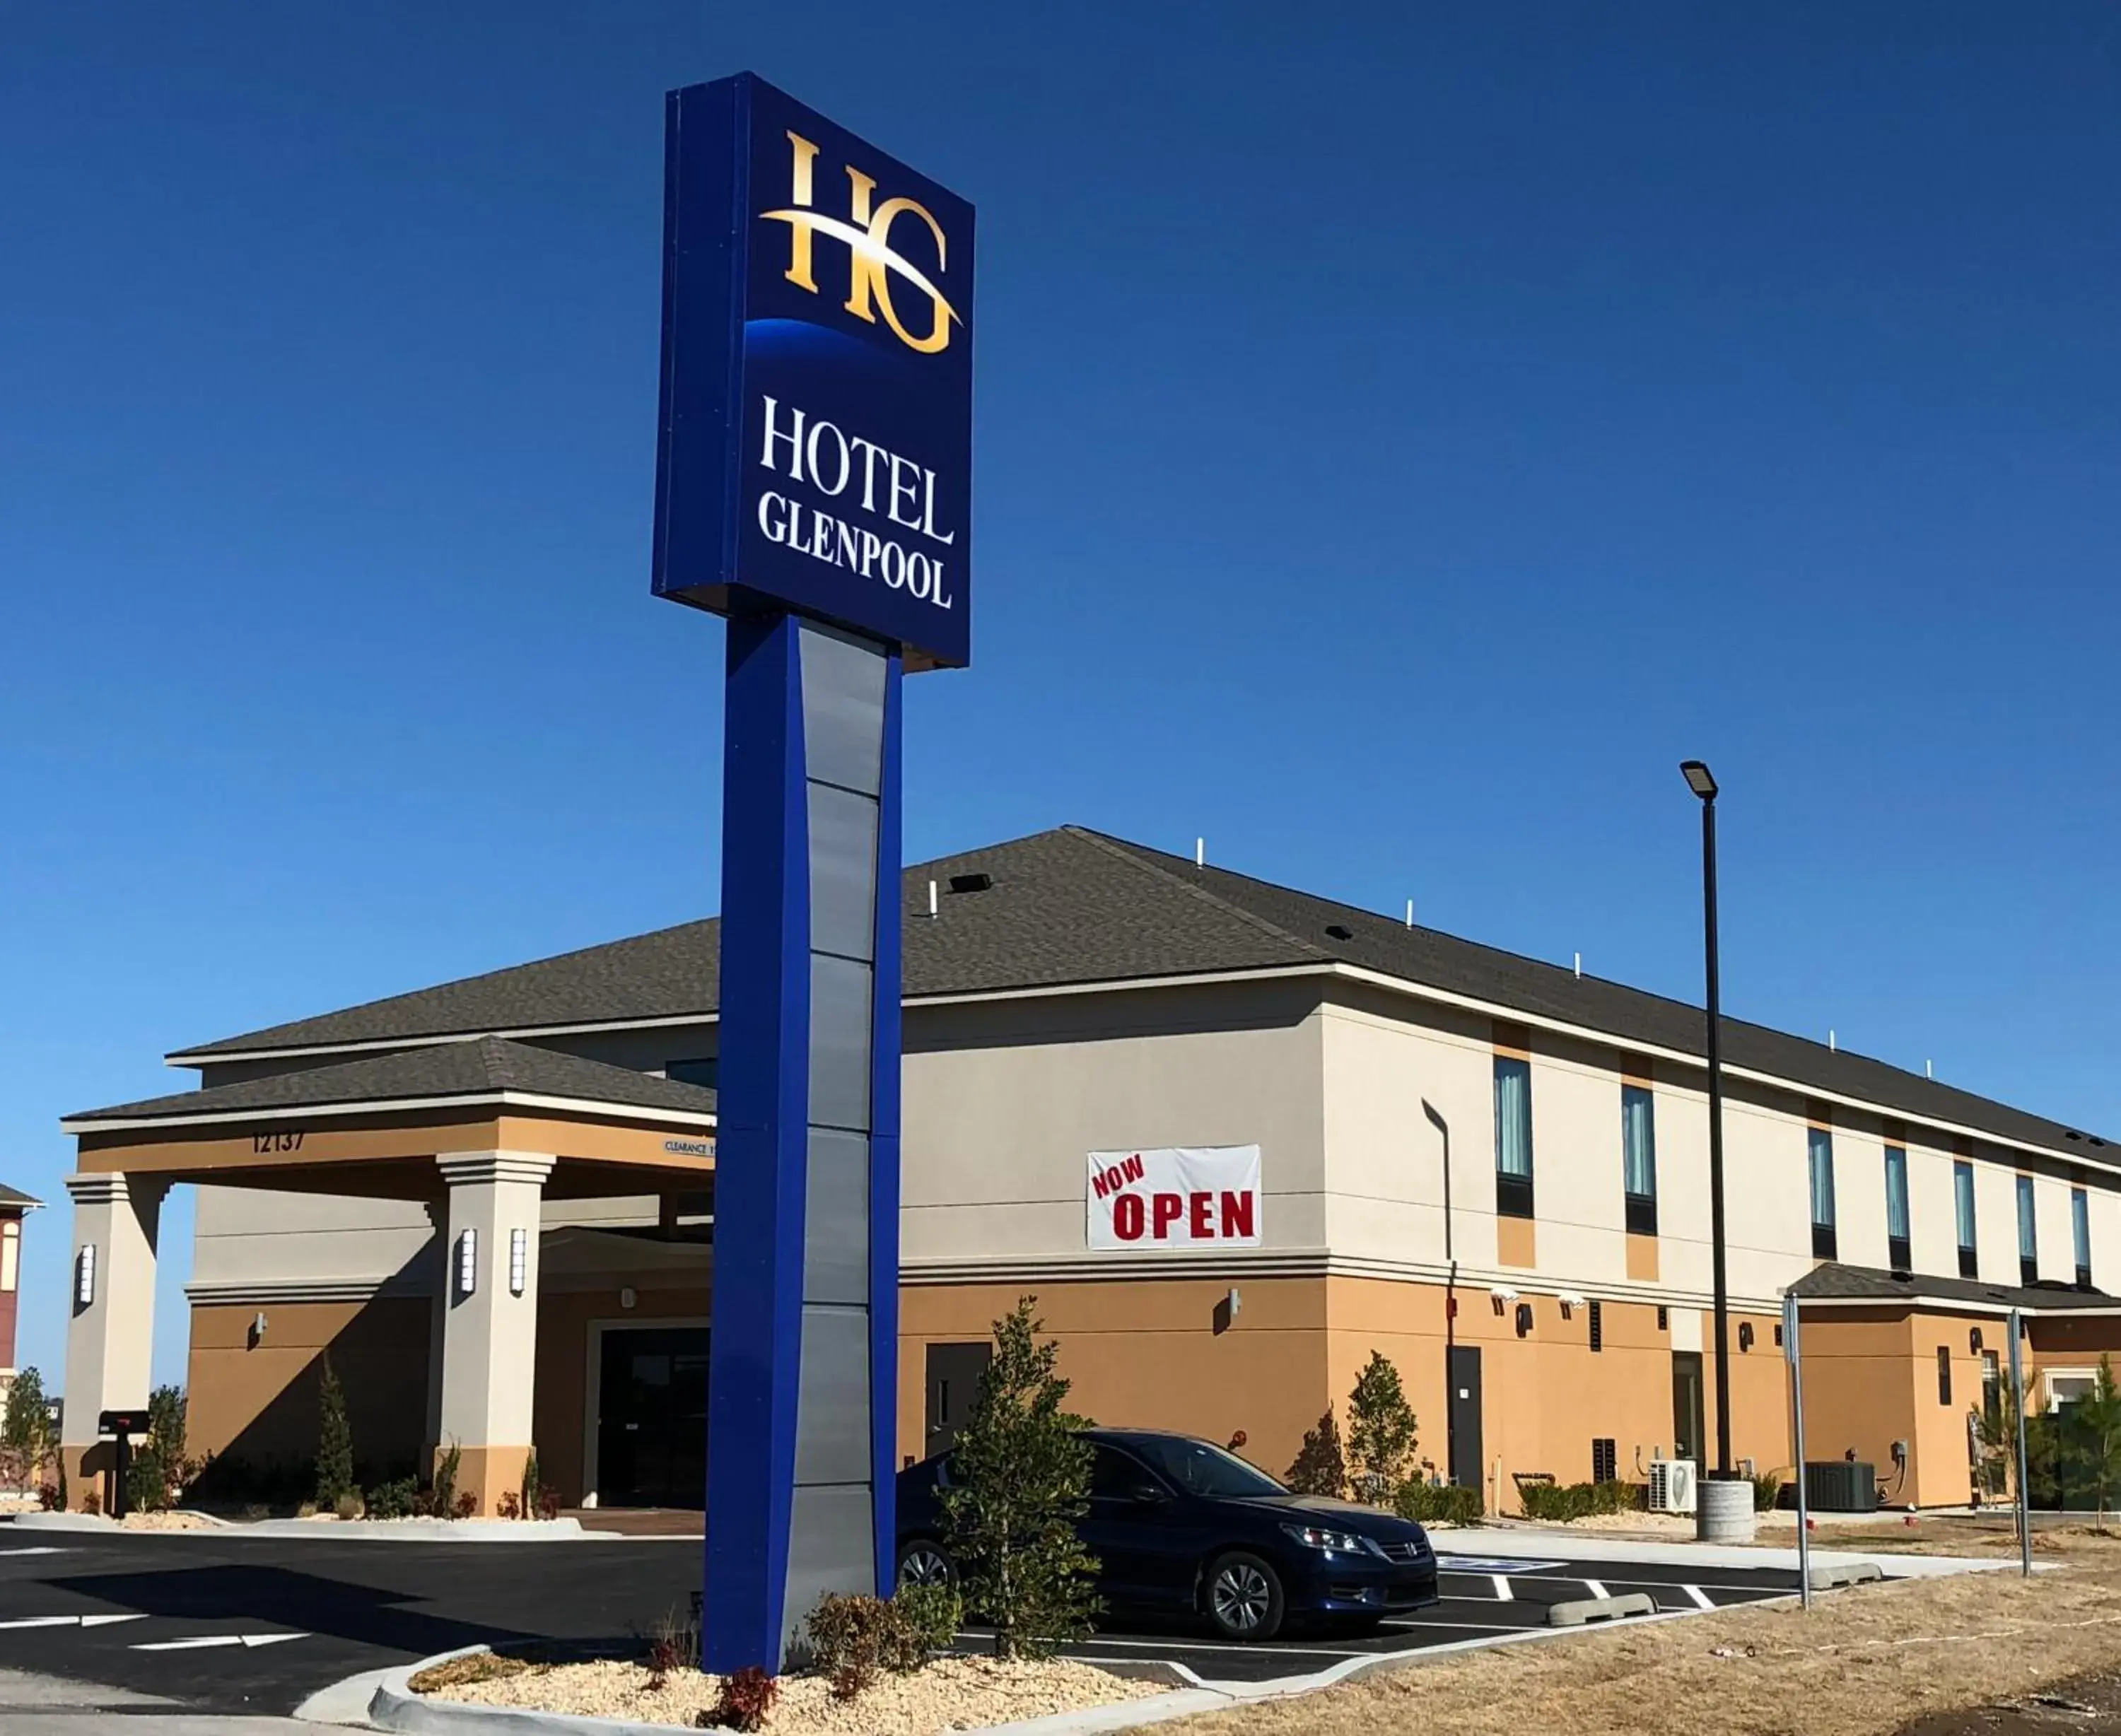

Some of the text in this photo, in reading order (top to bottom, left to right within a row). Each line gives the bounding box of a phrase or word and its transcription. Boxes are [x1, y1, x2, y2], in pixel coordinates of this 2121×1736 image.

[759, 394, 954, 546] HOTEL
[757, 491, 952, 610] GLENPOOL
[253, 1130, 305, 1154] 12137
[665, 1142, 706, 1154] CLEARANCE
[1092, 1154, 1144, 1199] NOW
[1113, 1190, 1254, 1241] OPEN
